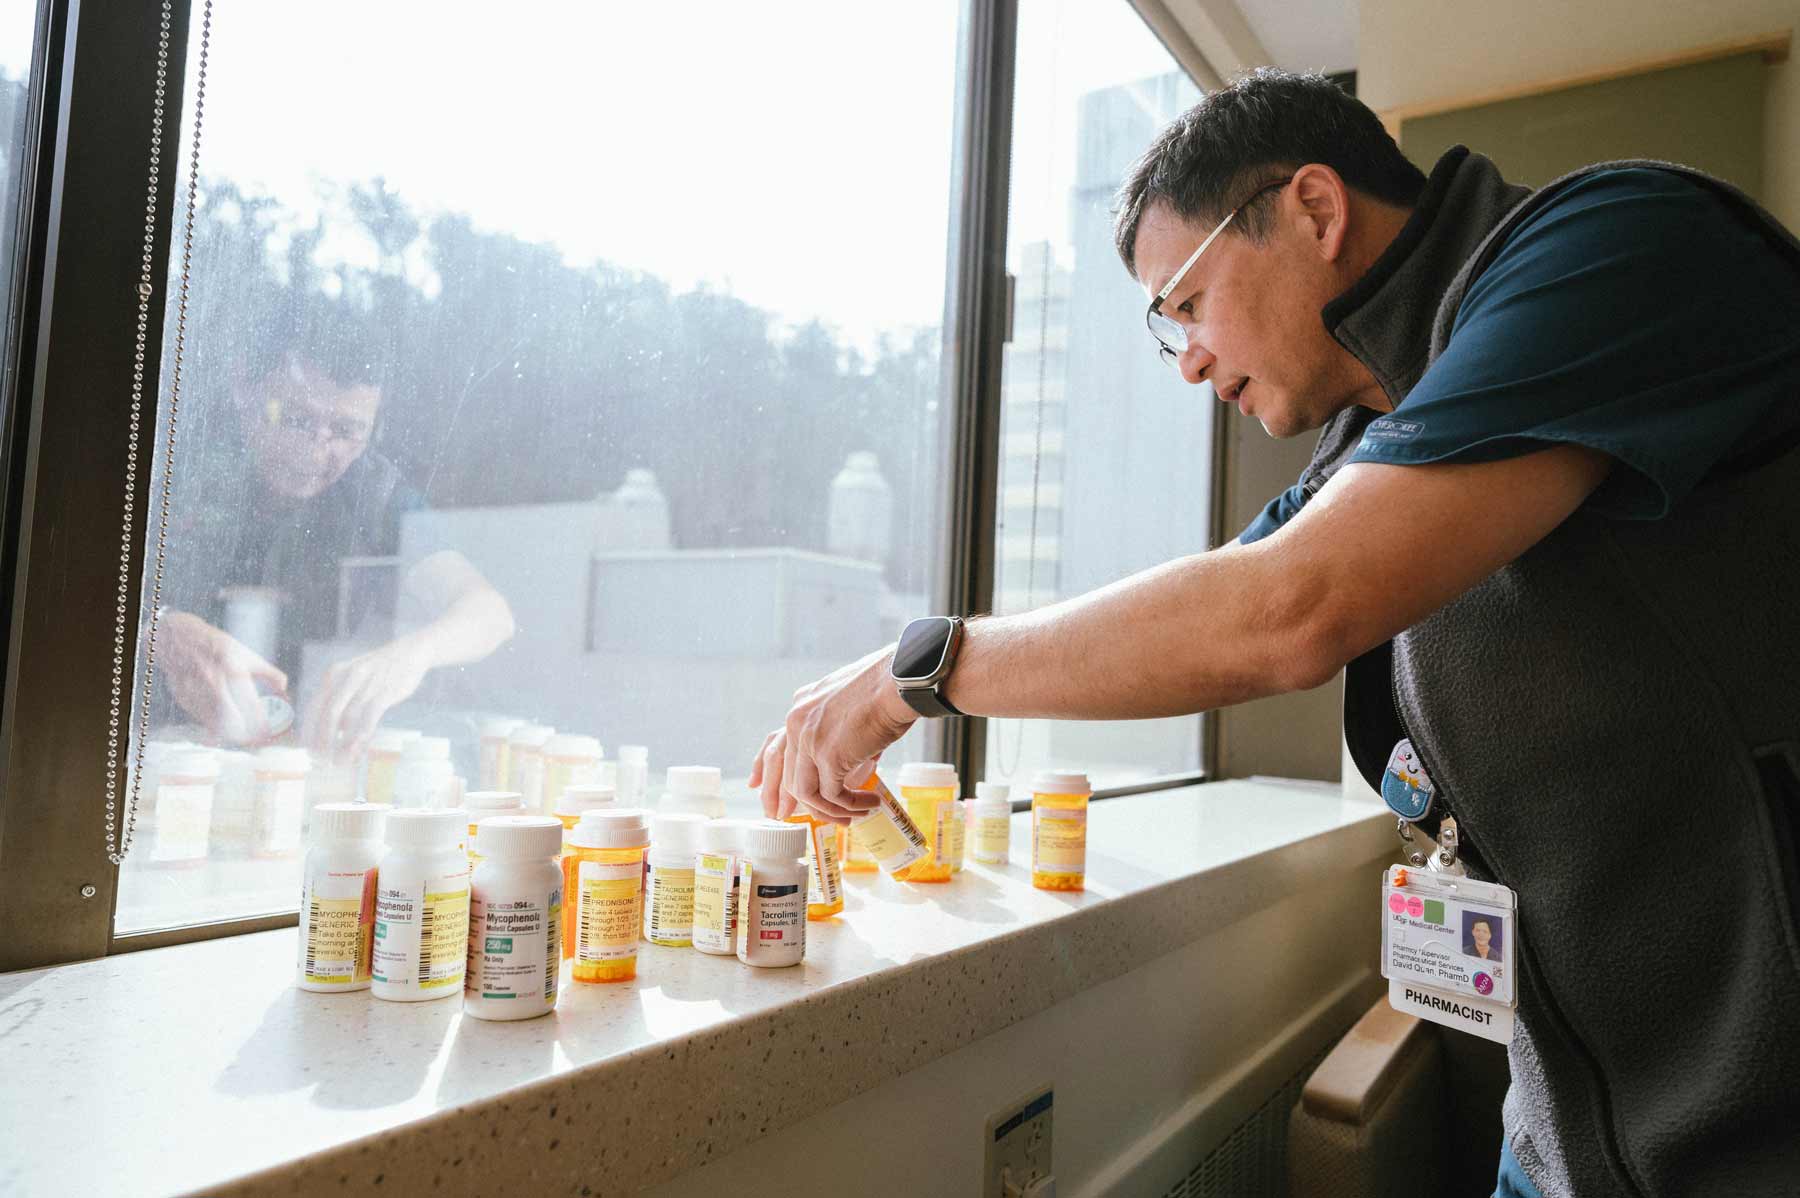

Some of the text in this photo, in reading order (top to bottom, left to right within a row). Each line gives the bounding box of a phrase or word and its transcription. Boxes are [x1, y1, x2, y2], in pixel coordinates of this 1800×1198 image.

[591, 897, 634, 907] PREDNISONE
[318, 920, 355, 928] GENERIC
[506, 924, 534, 933] Capsules
[1409, 919, 1433, 931] Medical
[1433, 924, 1456, 935] Center
[1392, 958, 1413, 970] David
[1438, 969, 1470, 984] PharmD
[1438, 959, 1465, 973] Services
[1405, 988, 1493, 1026] PHARMACIST
